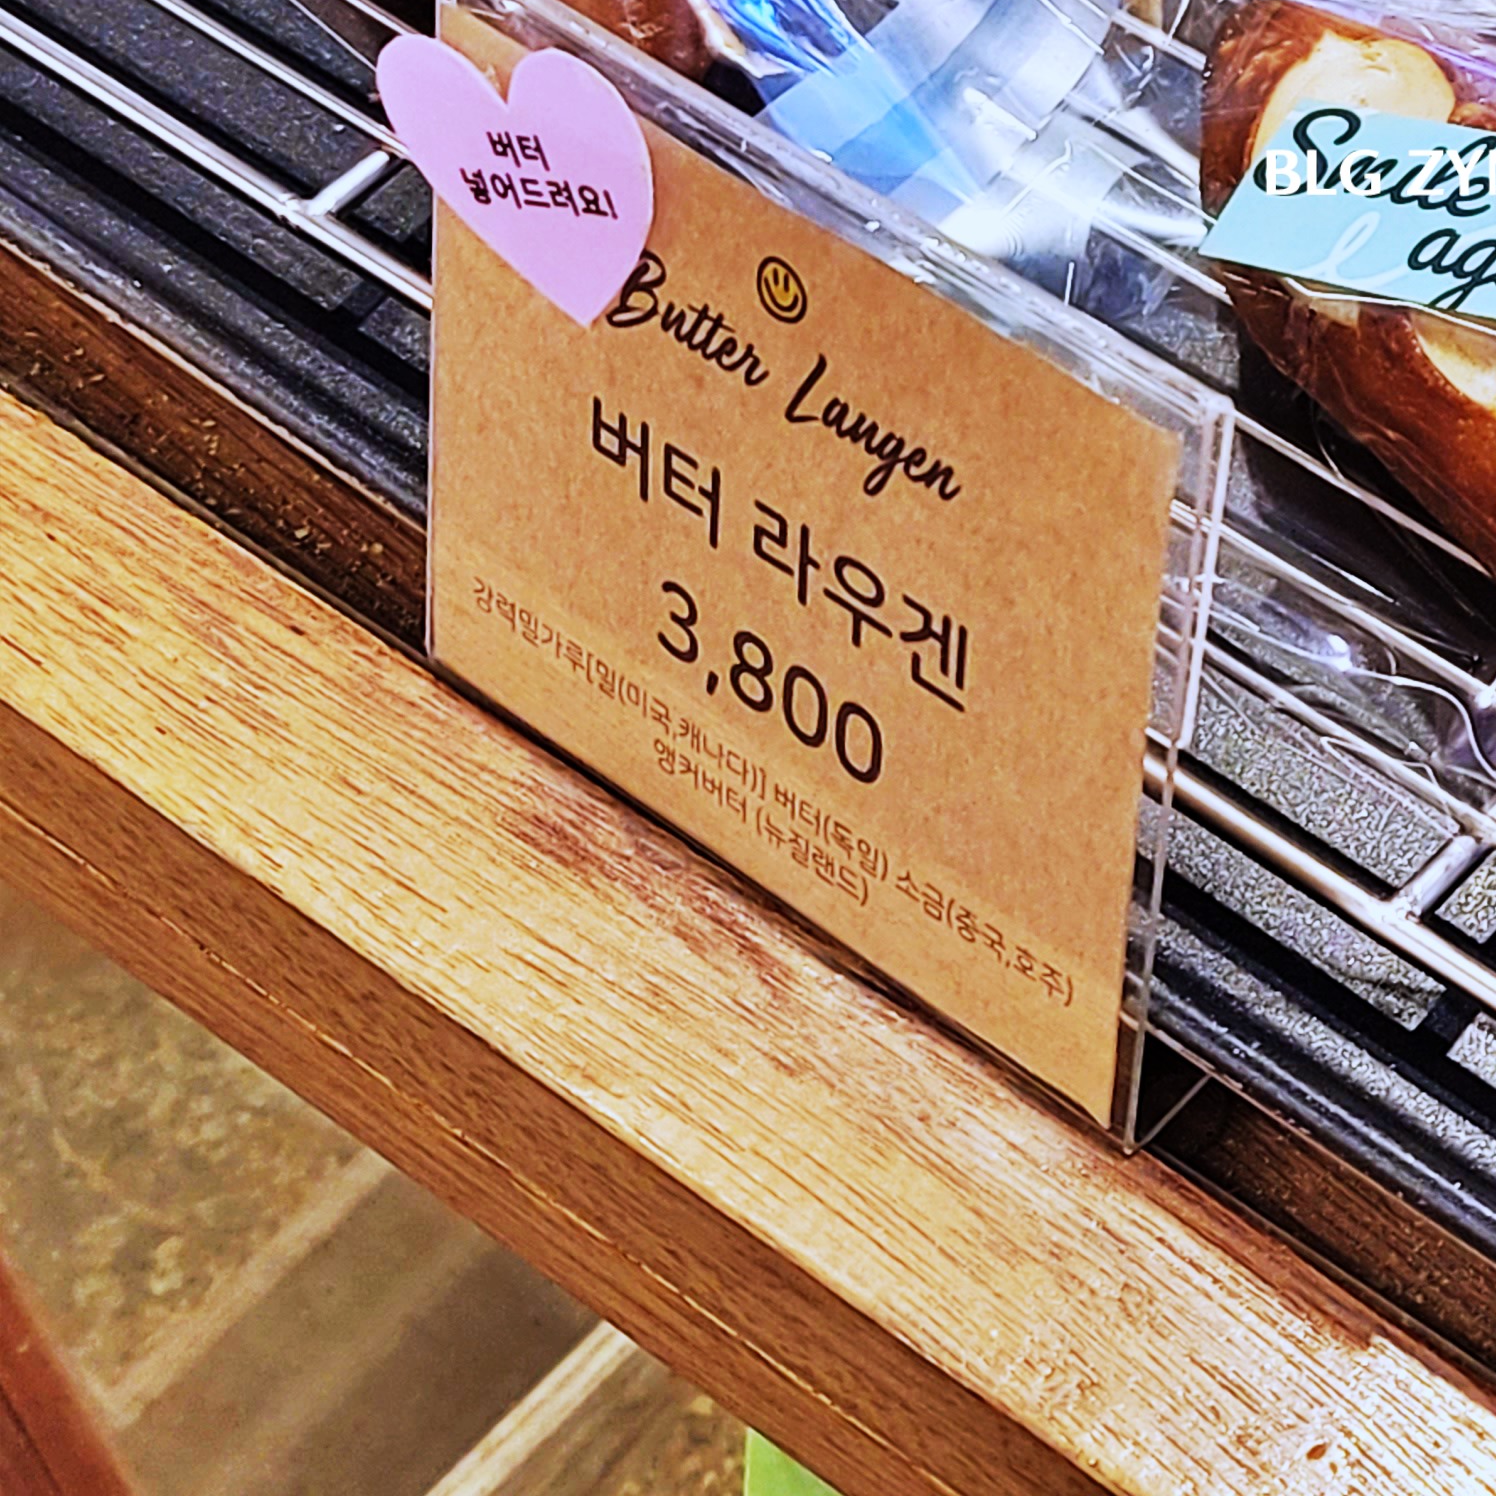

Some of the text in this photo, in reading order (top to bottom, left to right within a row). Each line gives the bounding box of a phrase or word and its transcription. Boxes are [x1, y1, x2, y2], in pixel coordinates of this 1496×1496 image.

[459, 167, 618, 220] 넣어드려요!
[486, 131, 550, 172] 버터
[606, 249, 961, 501] Butter Laugen
[590, 395, 968, 712] 버터 라우겐
[657, 581, 883, 784] 3,800
[654, 738, 868, 906] 앵커버터 (뉴질랜드)
[775, 783, 888, 881] 버터(독일)
[895, 870, 1073, 1007] 소금(중국,호주)
